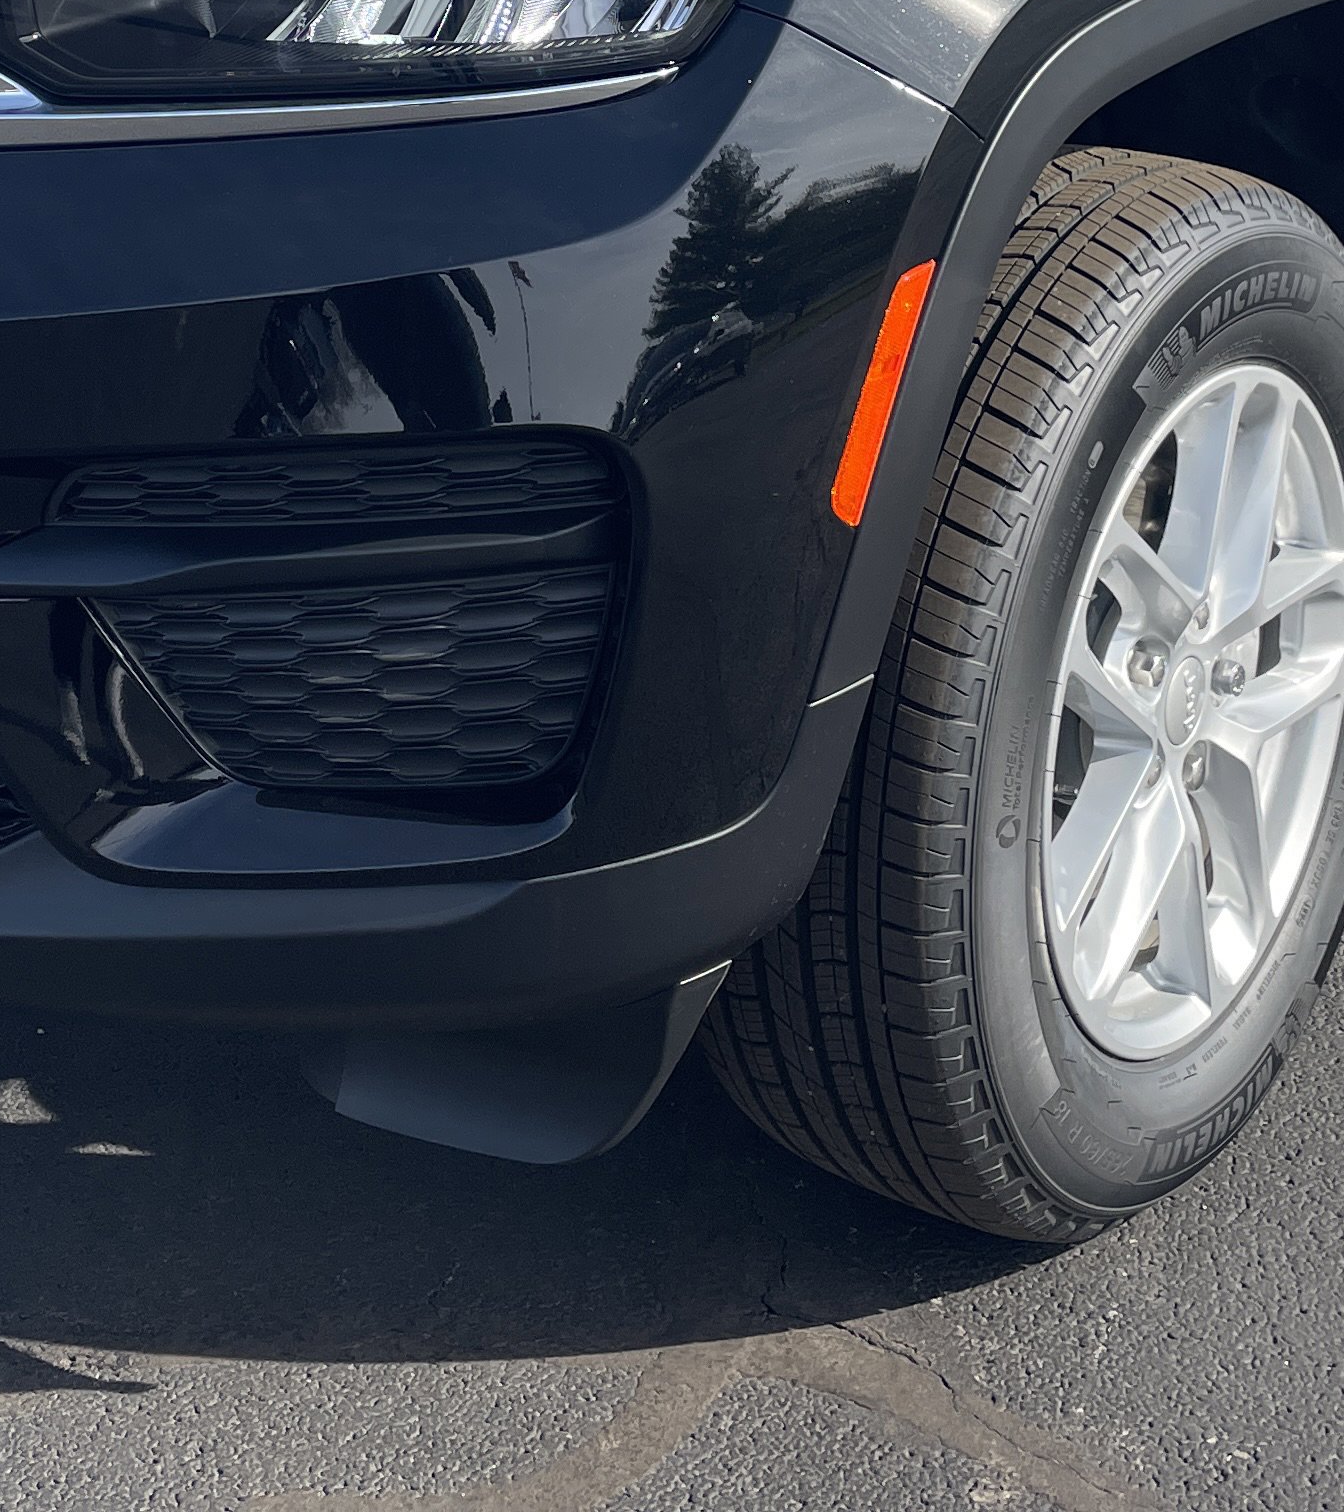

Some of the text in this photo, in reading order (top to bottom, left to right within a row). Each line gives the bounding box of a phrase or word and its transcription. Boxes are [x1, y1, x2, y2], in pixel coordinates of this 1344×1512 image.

[1198, 270, 1318, 340] MICHELIN
[1001, 725, 1021, 809] MICHELIN
[1013, 782, 1022, 811] Total
[1151, 1051, 1274, 1175] MICHELIN
